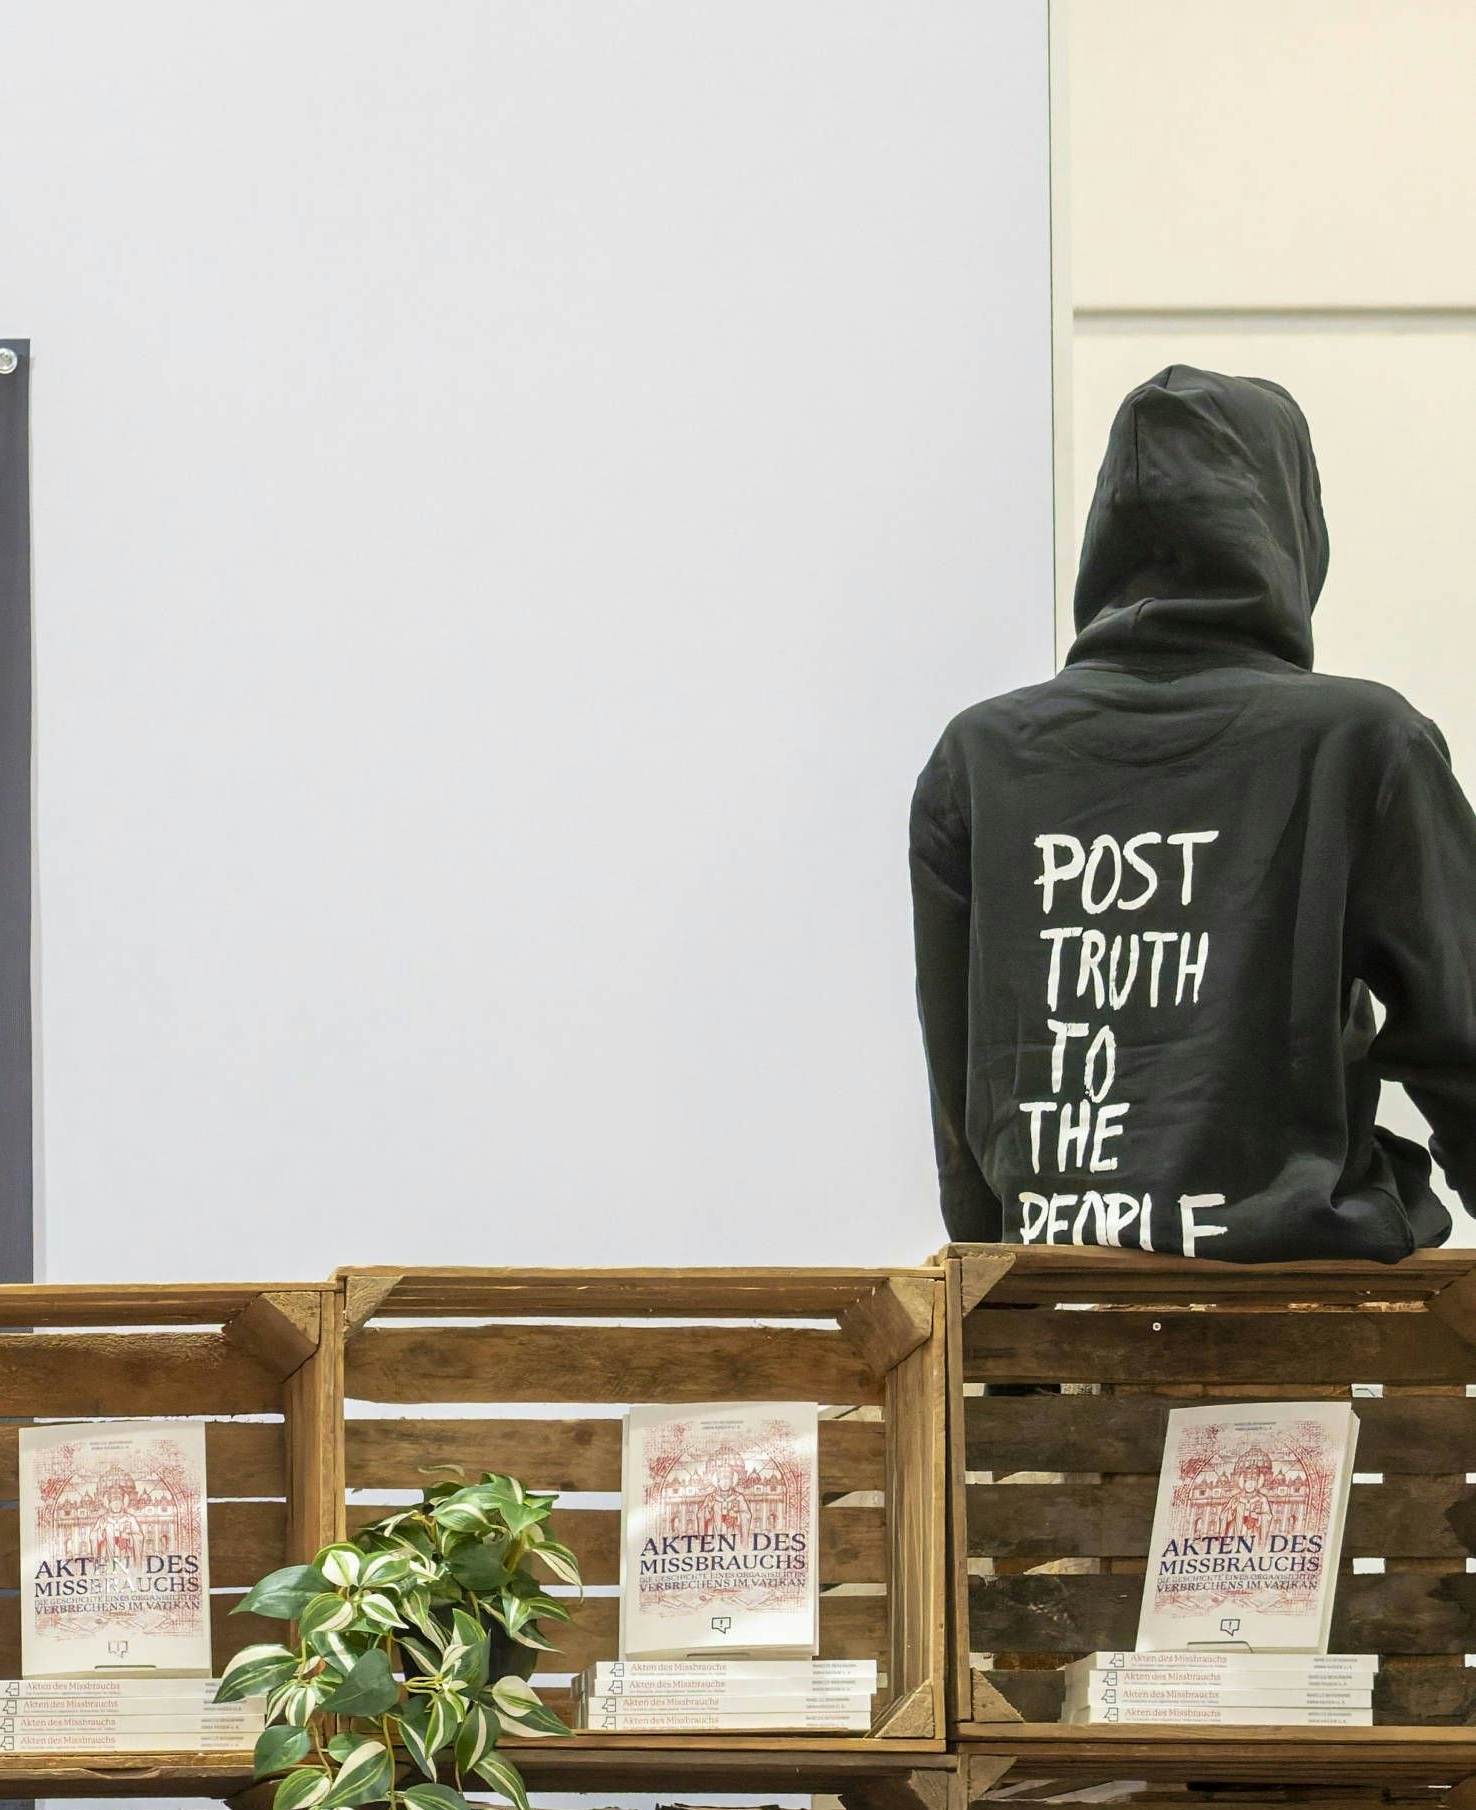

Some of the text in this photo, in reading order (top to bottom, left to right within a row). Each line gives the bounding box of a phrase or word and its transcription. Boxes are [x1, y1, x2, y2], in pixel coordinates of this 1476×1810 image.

[1034, 831, 1220, 914] POST
[1040, 926, 1209, 1011] TRUTH
[1047, 1019, 1116, 1103] TO
[1019, 1100, 1130, 1174] THE
[640, 1533, 806, 1557] AKTEN DES
[1162, 1535, 1322, 1557] AKTEN DES
[34, 1555, 198, 1579] AKTEN DES
[640, 1555, 805, 1575] MISSBRAUCHS
[1158, 1556, 1319, 1576] MISSBRAUCHS
[34, 1577, 199, 1597] MISSBRAUCHS
